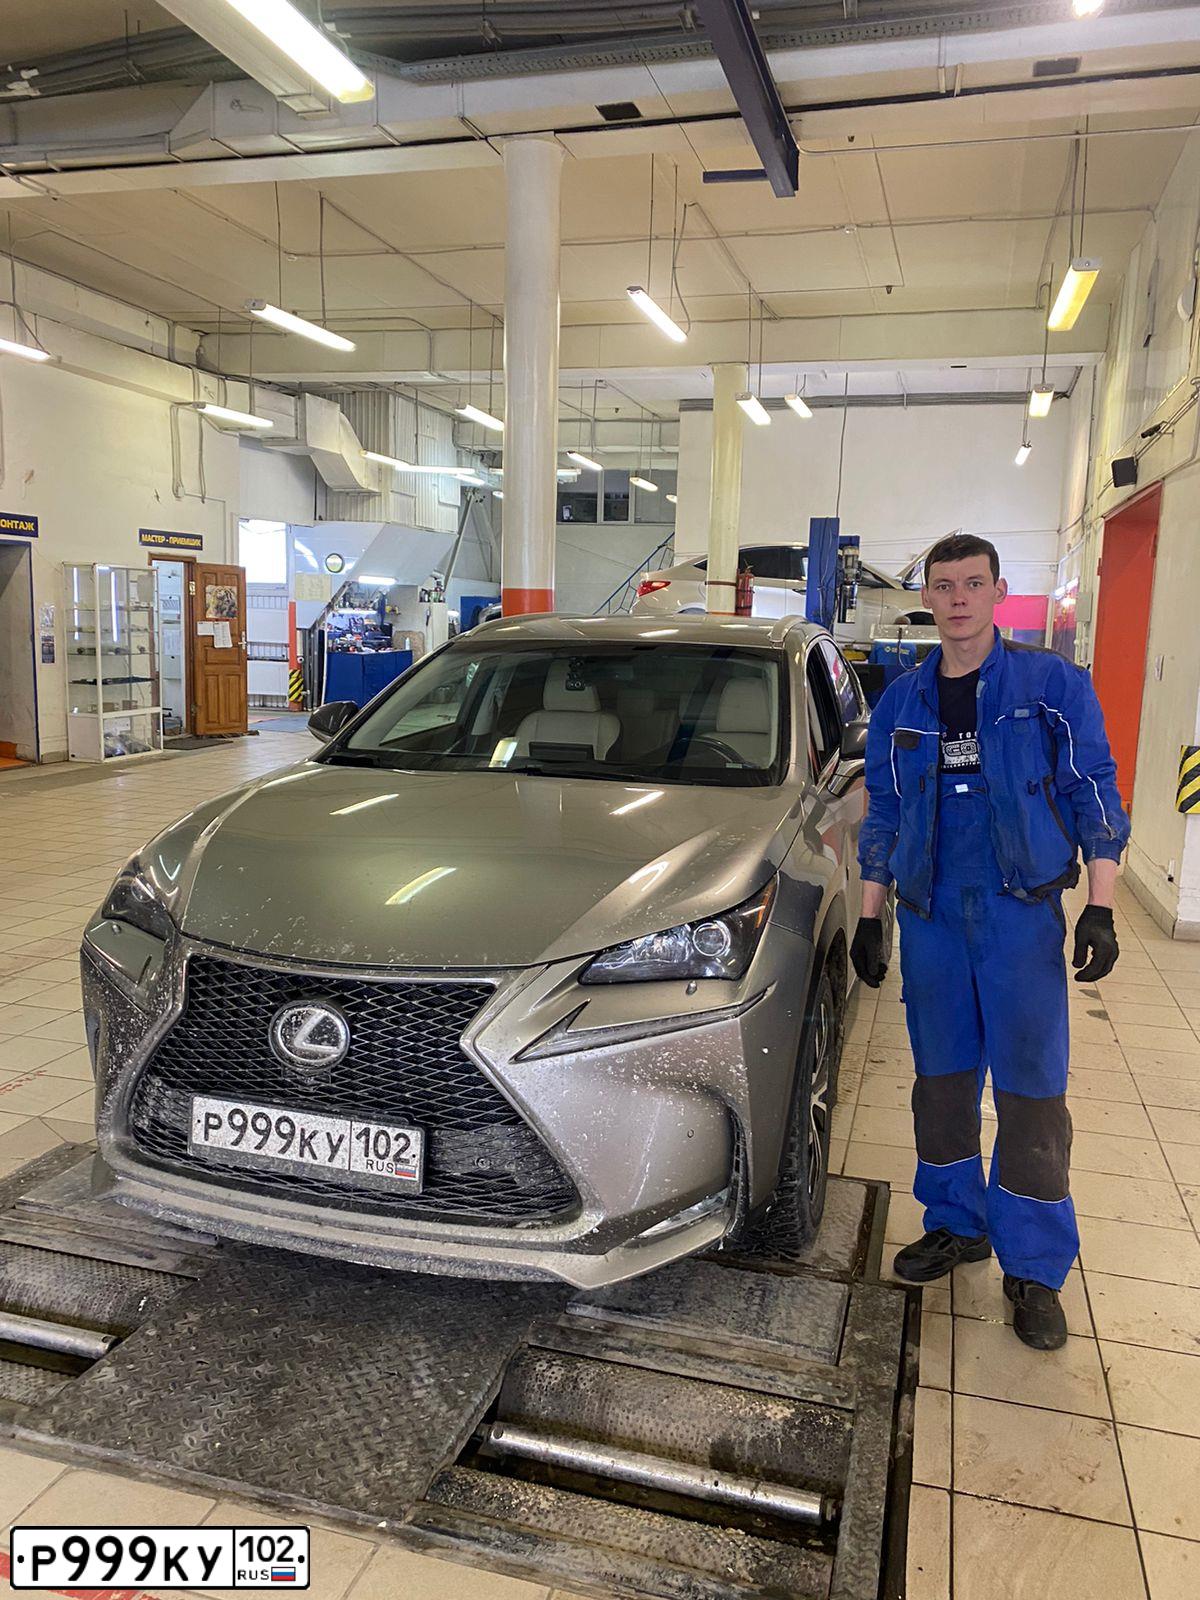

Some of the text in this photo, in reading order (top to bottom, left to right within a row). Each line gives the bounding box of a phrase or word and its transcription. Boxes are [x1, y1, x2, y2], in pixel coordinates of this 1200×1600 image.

[141, 533, 165, 543] МАСТЕР
[204, 1108, 412, 1164] Р999КУ 102
[365, 1158, 395, 1175] RUS
